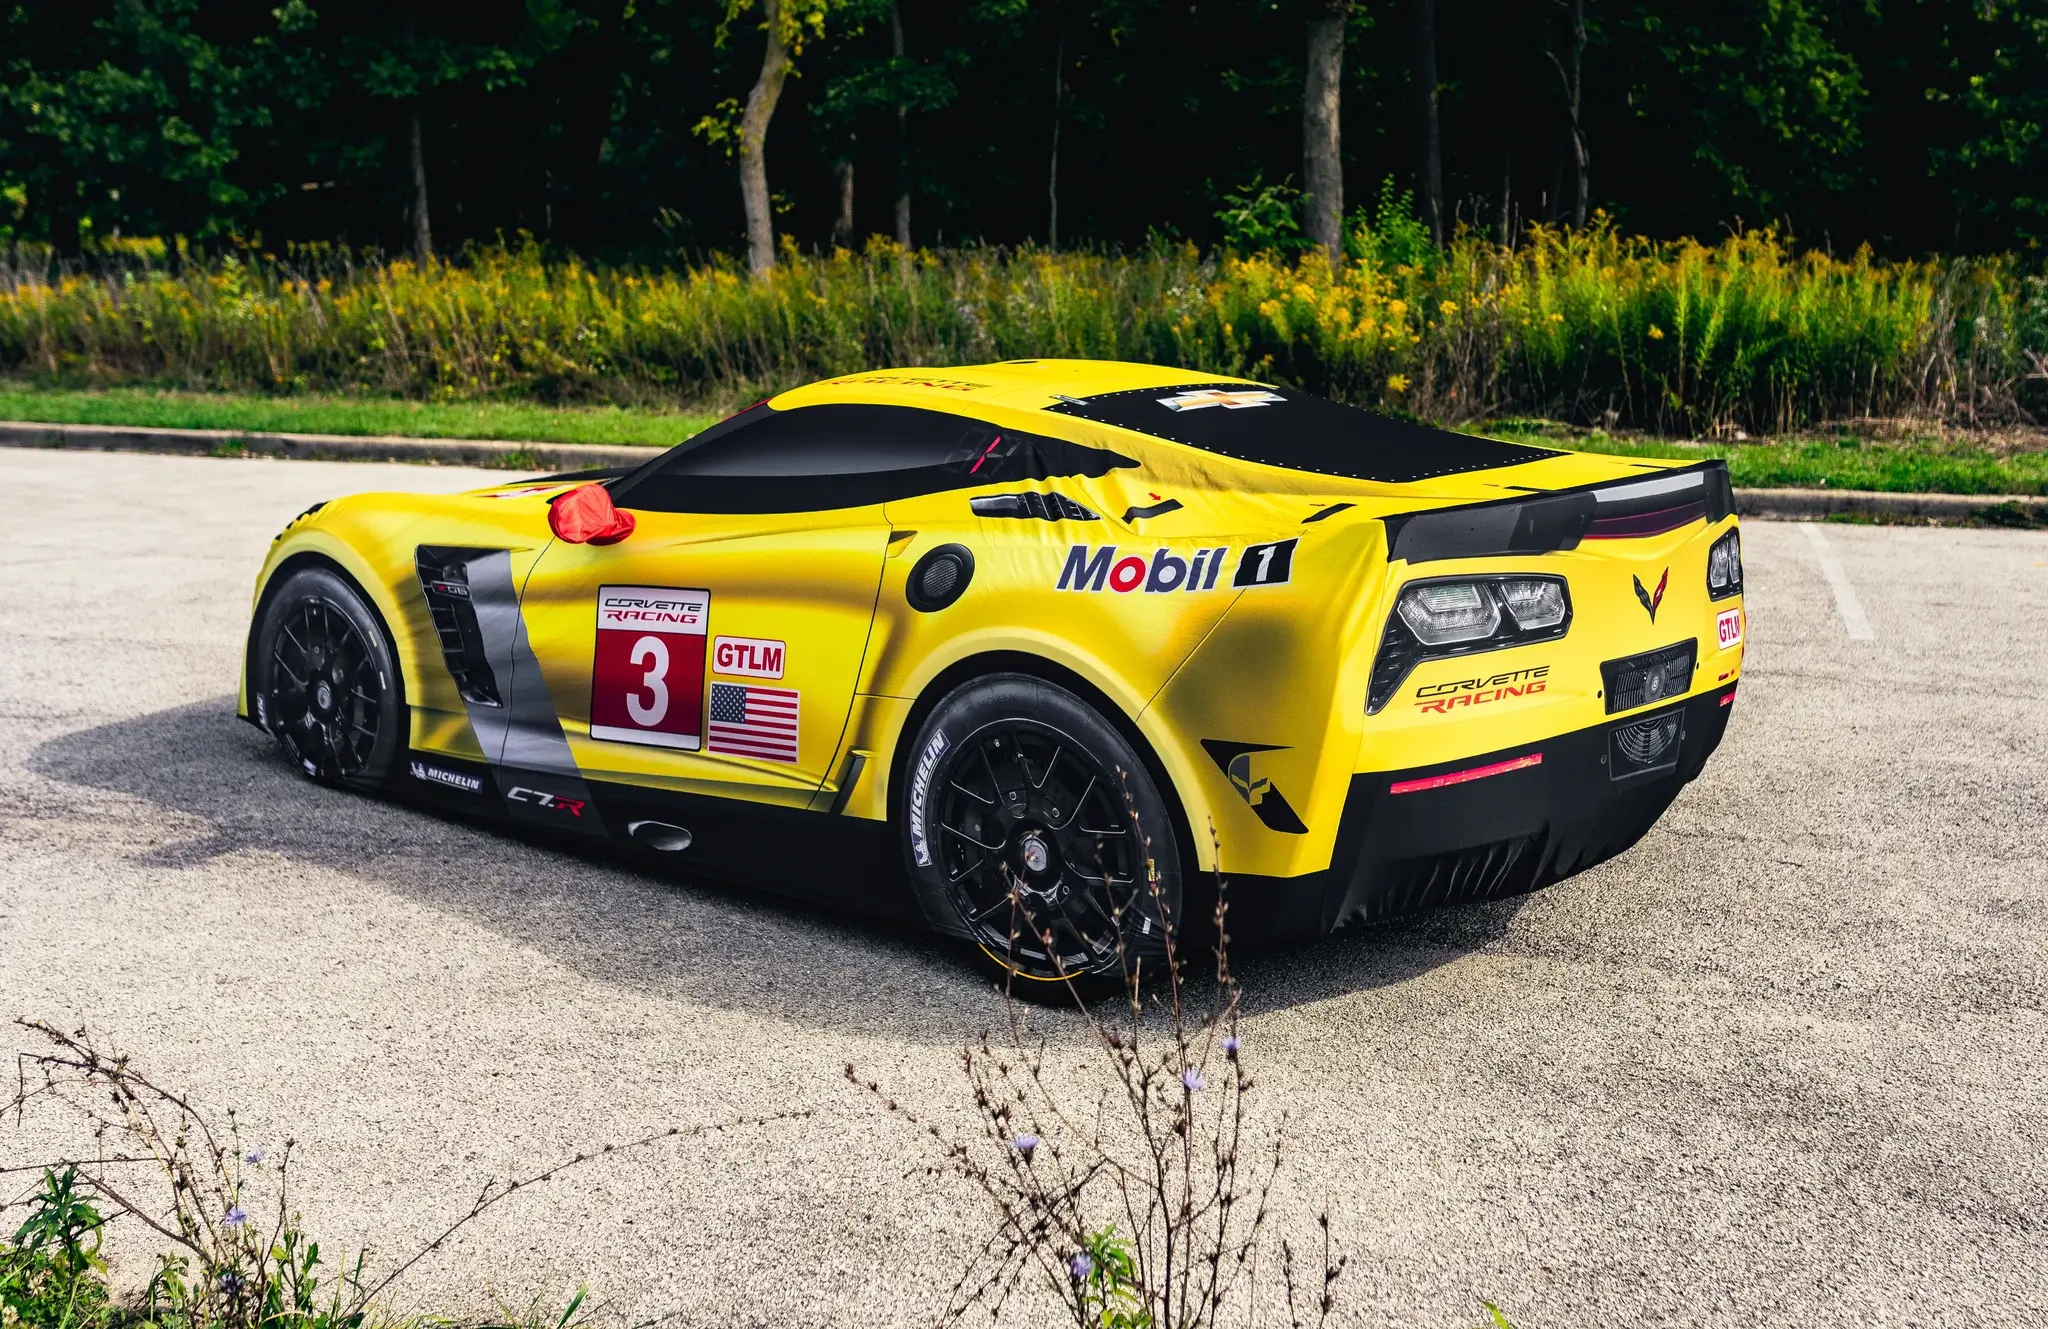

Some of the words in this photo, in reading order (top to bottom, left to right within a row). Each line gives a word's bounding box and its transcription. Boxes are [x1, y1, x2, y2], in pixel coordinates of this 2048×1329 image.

[1056, 545, 1228, 593] Mobil
[1257, 545, 1277, 582] 1
[603, 609, 698, 624] RACING
[604, 598, 703, 612] CORVETTE
[717, 643, 782, 672] GTLM
[626, 635, 670, 727] 3
[1414, 680, 1546, 713] RACING
[1416, 665, 1550, 698] CORVETTE
[427, 767, 480, 790] MICHELIN
[911, 733, 946, 838] MICHELIN
